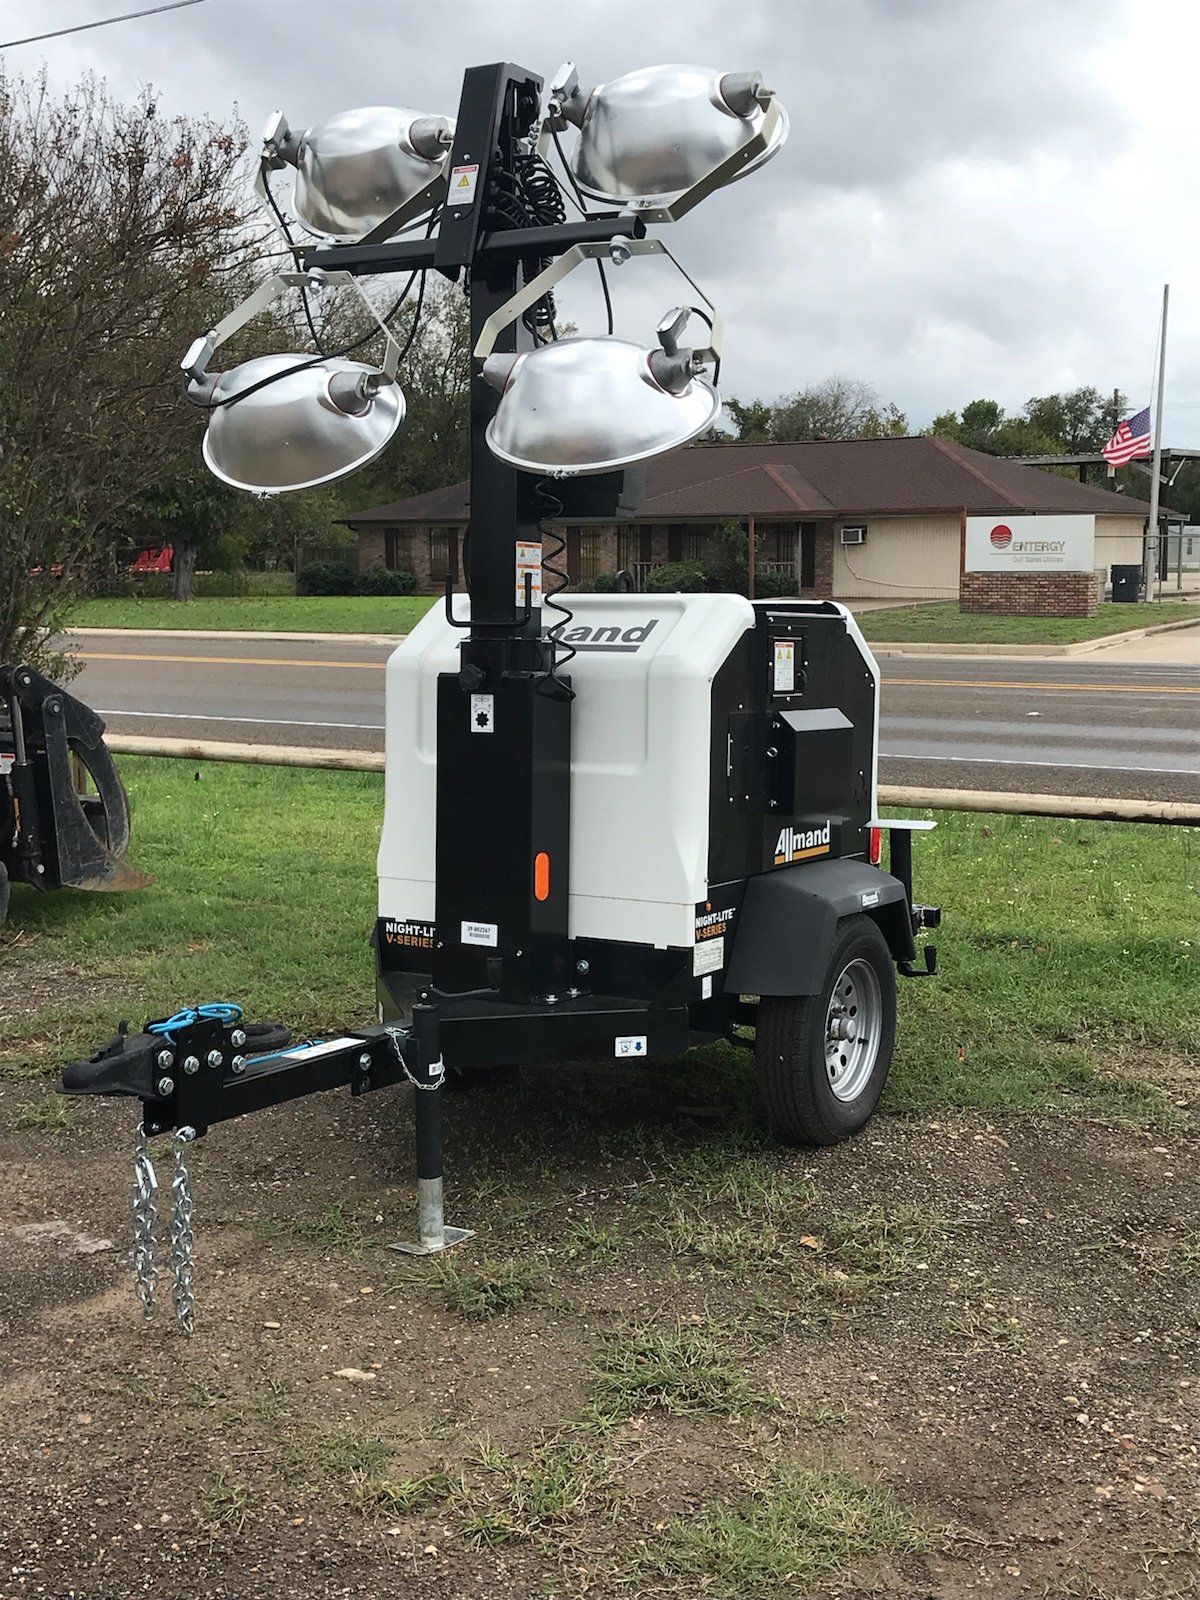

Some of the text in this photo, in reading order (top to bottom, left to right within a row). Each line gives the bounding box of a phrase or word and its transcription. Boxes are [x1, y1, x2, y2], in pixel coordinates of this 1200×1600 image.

[1012, 541, 1066, 552] ENTERGY
[775, 820, 830, 862] Allmand
[695, 908, 734, 929] NIGHT-LITE
[386, 922, 436, 938] NIGHT-LI
[695, 922, 727, 940] V-SERIES
